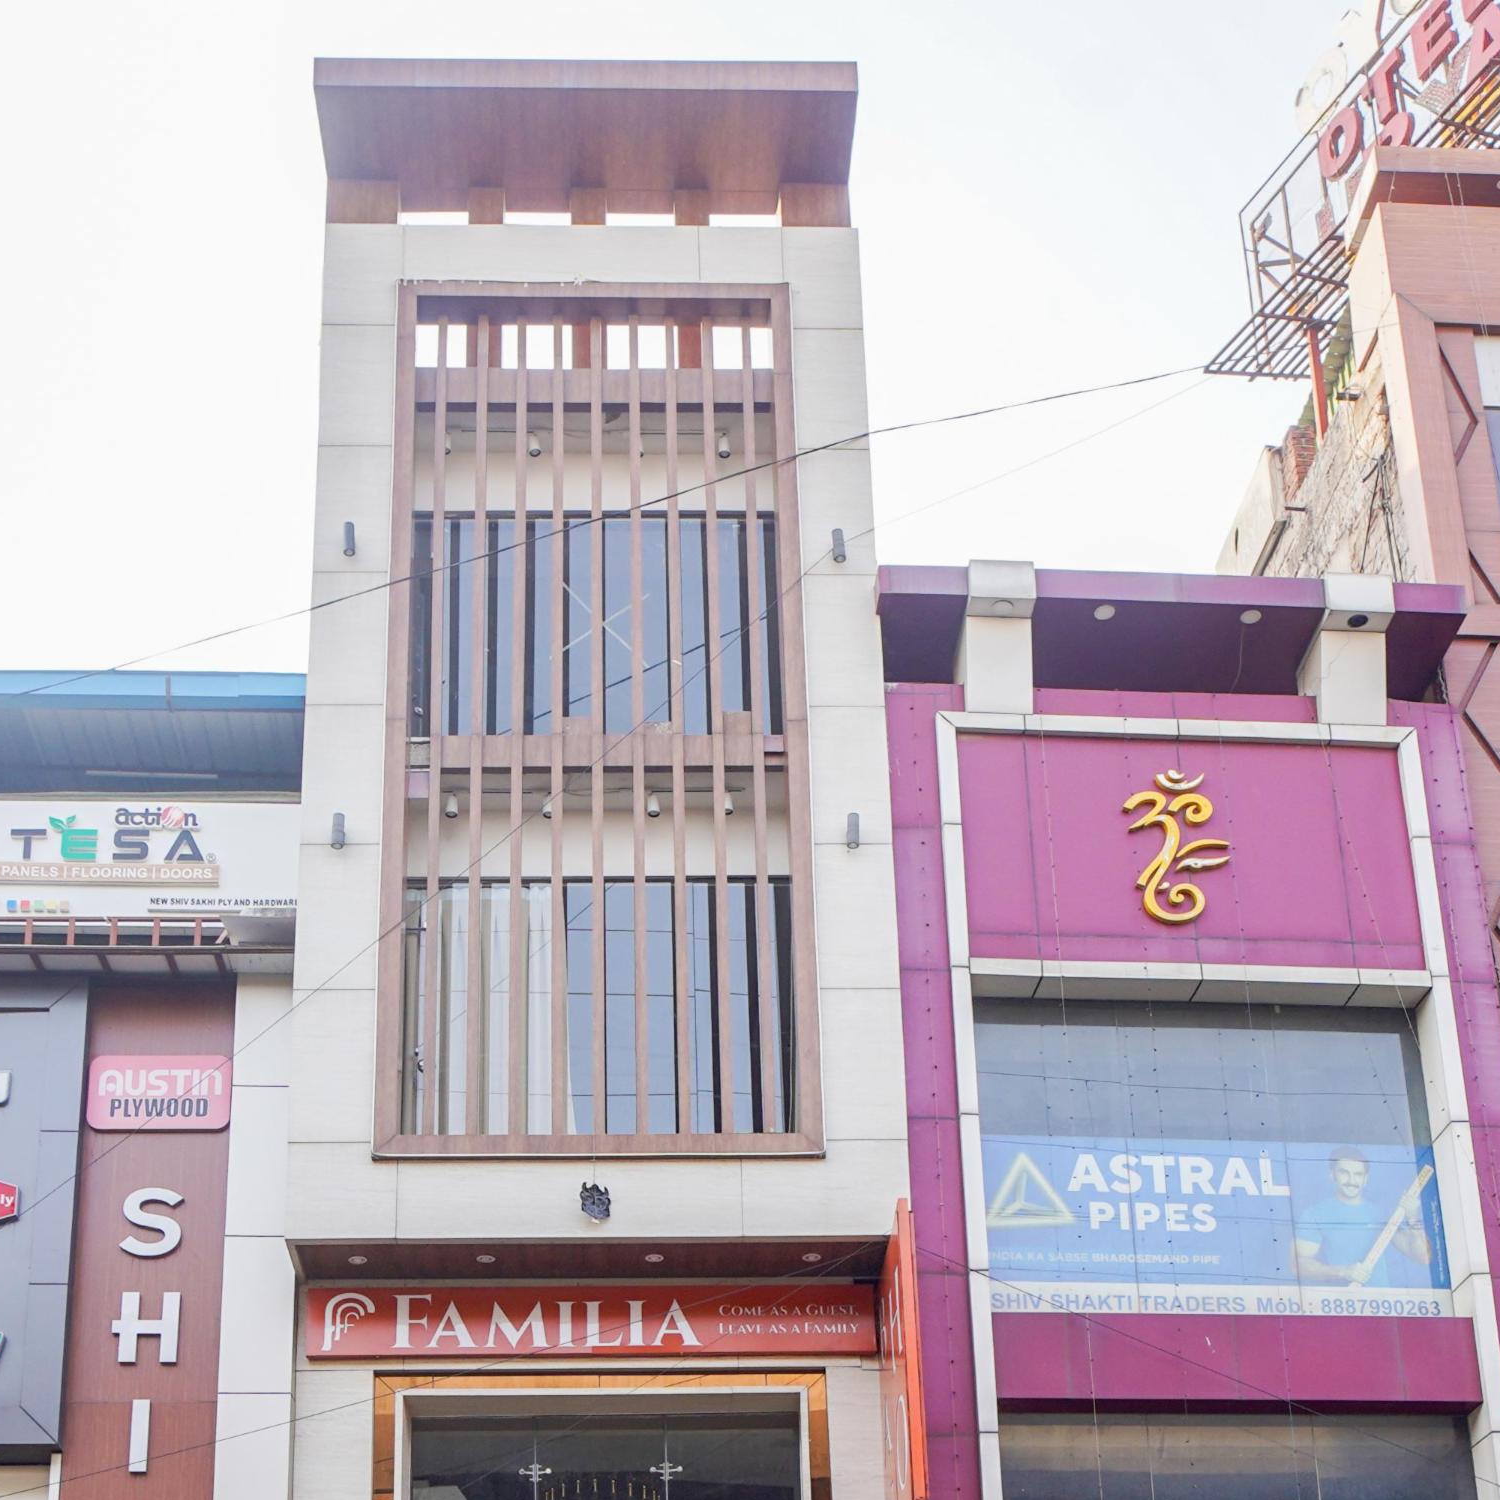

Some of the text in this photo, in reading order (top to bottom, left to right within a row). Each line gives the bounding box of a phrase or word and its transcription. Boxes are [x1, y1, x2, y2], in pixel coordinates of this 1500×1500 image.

[115, 807, 199, 828] action
[11, 828, 206, 861] TESA
[1, 865, 212, 879] PANELS FLOORING DOORS
[191, 898, 216, 906] SAKHI
[218, 898, 232, 906] PLY
[98, 1068, 222, 1097] AUSTIN
[110, 1097, 209, 1117] PLYWOOD
[1068, 1153, 1291, 1197] ASTRAL
[1090, 1202, 1218, 1233] PIPES
[991, 1293, 1041, 1310] SHIV
[1050, 1294, 1133, 1312] SHAKTI
[1142, 1295, 1246, 1314] TRADERS
[390, 1294, 703, 1349] FAMILIA
